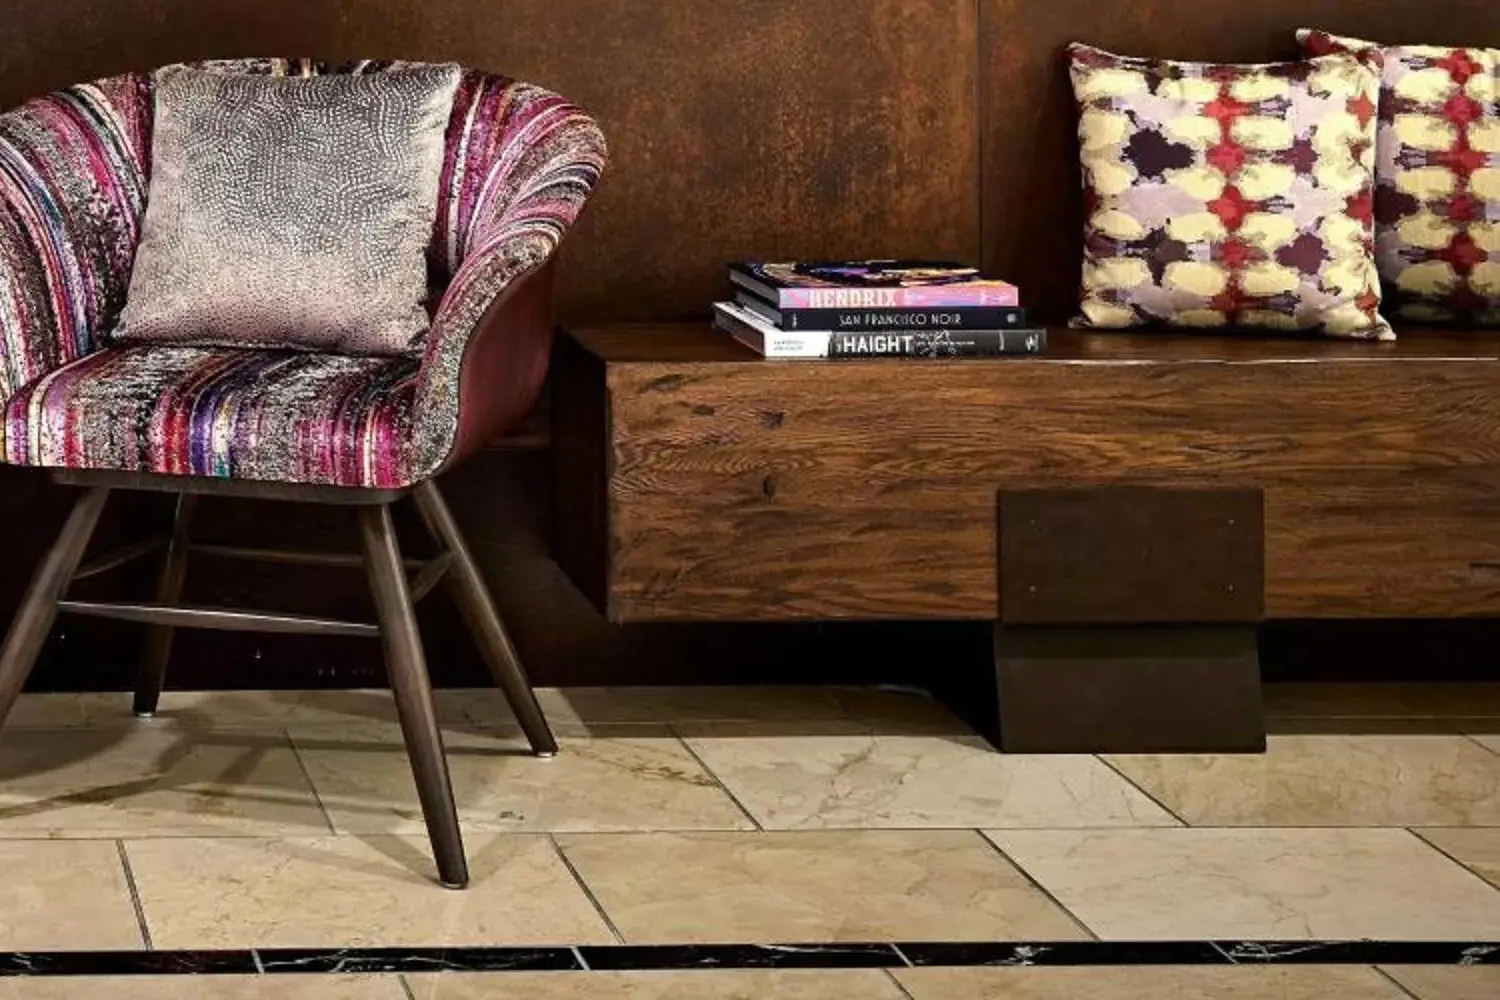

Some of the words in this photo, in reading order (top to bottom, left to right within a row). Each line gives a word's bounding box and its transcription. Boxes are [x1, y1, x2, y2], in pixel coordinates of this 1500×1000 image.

[809, 289, 897, 307] HENDRIX
[839, 314, 861, 326] SAN
[865, 313, 928, 326] FRANCISCO
[931, 313, 962, 325] NOIR
[843, 335, 914, 353] HAIGHT
